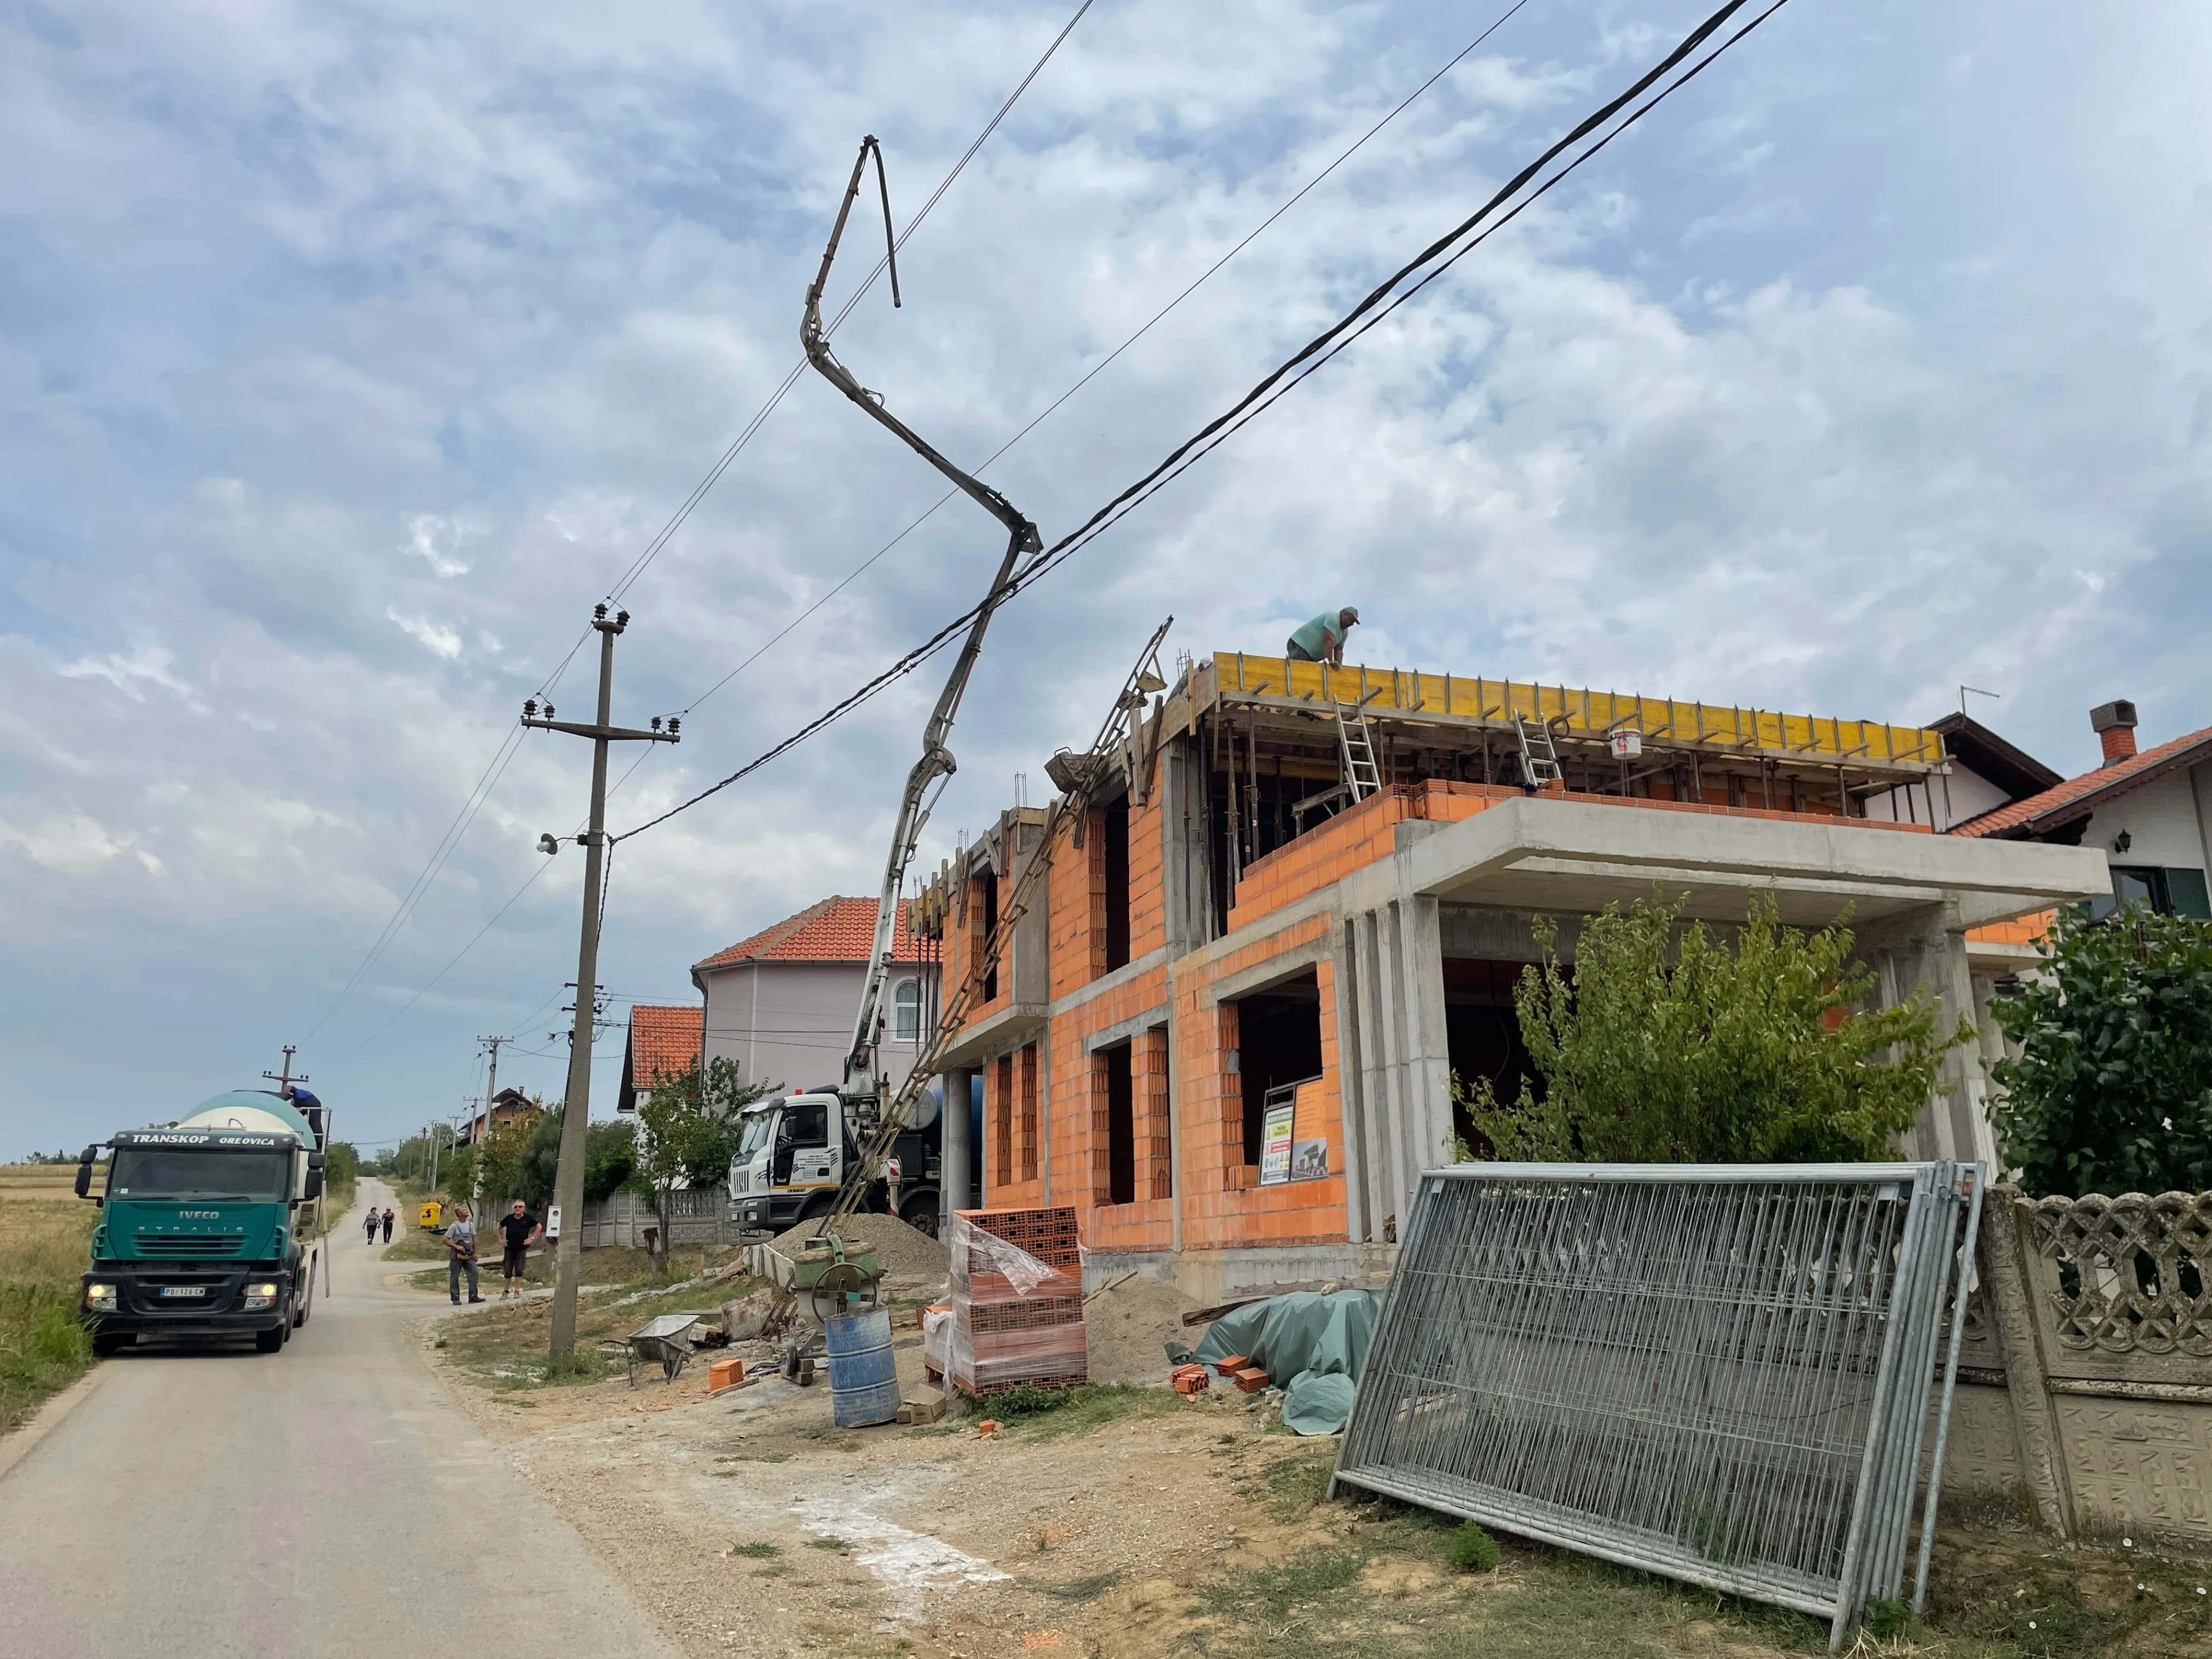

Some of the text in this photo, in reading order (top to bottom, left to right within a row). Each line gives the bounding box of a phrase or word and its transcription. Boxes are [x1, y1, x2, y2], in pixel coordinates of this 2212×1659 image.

[132, 1134, 275, 1146] TRANSKOP OREOVICA
[179, 1211, 219, 1219] IVECO
